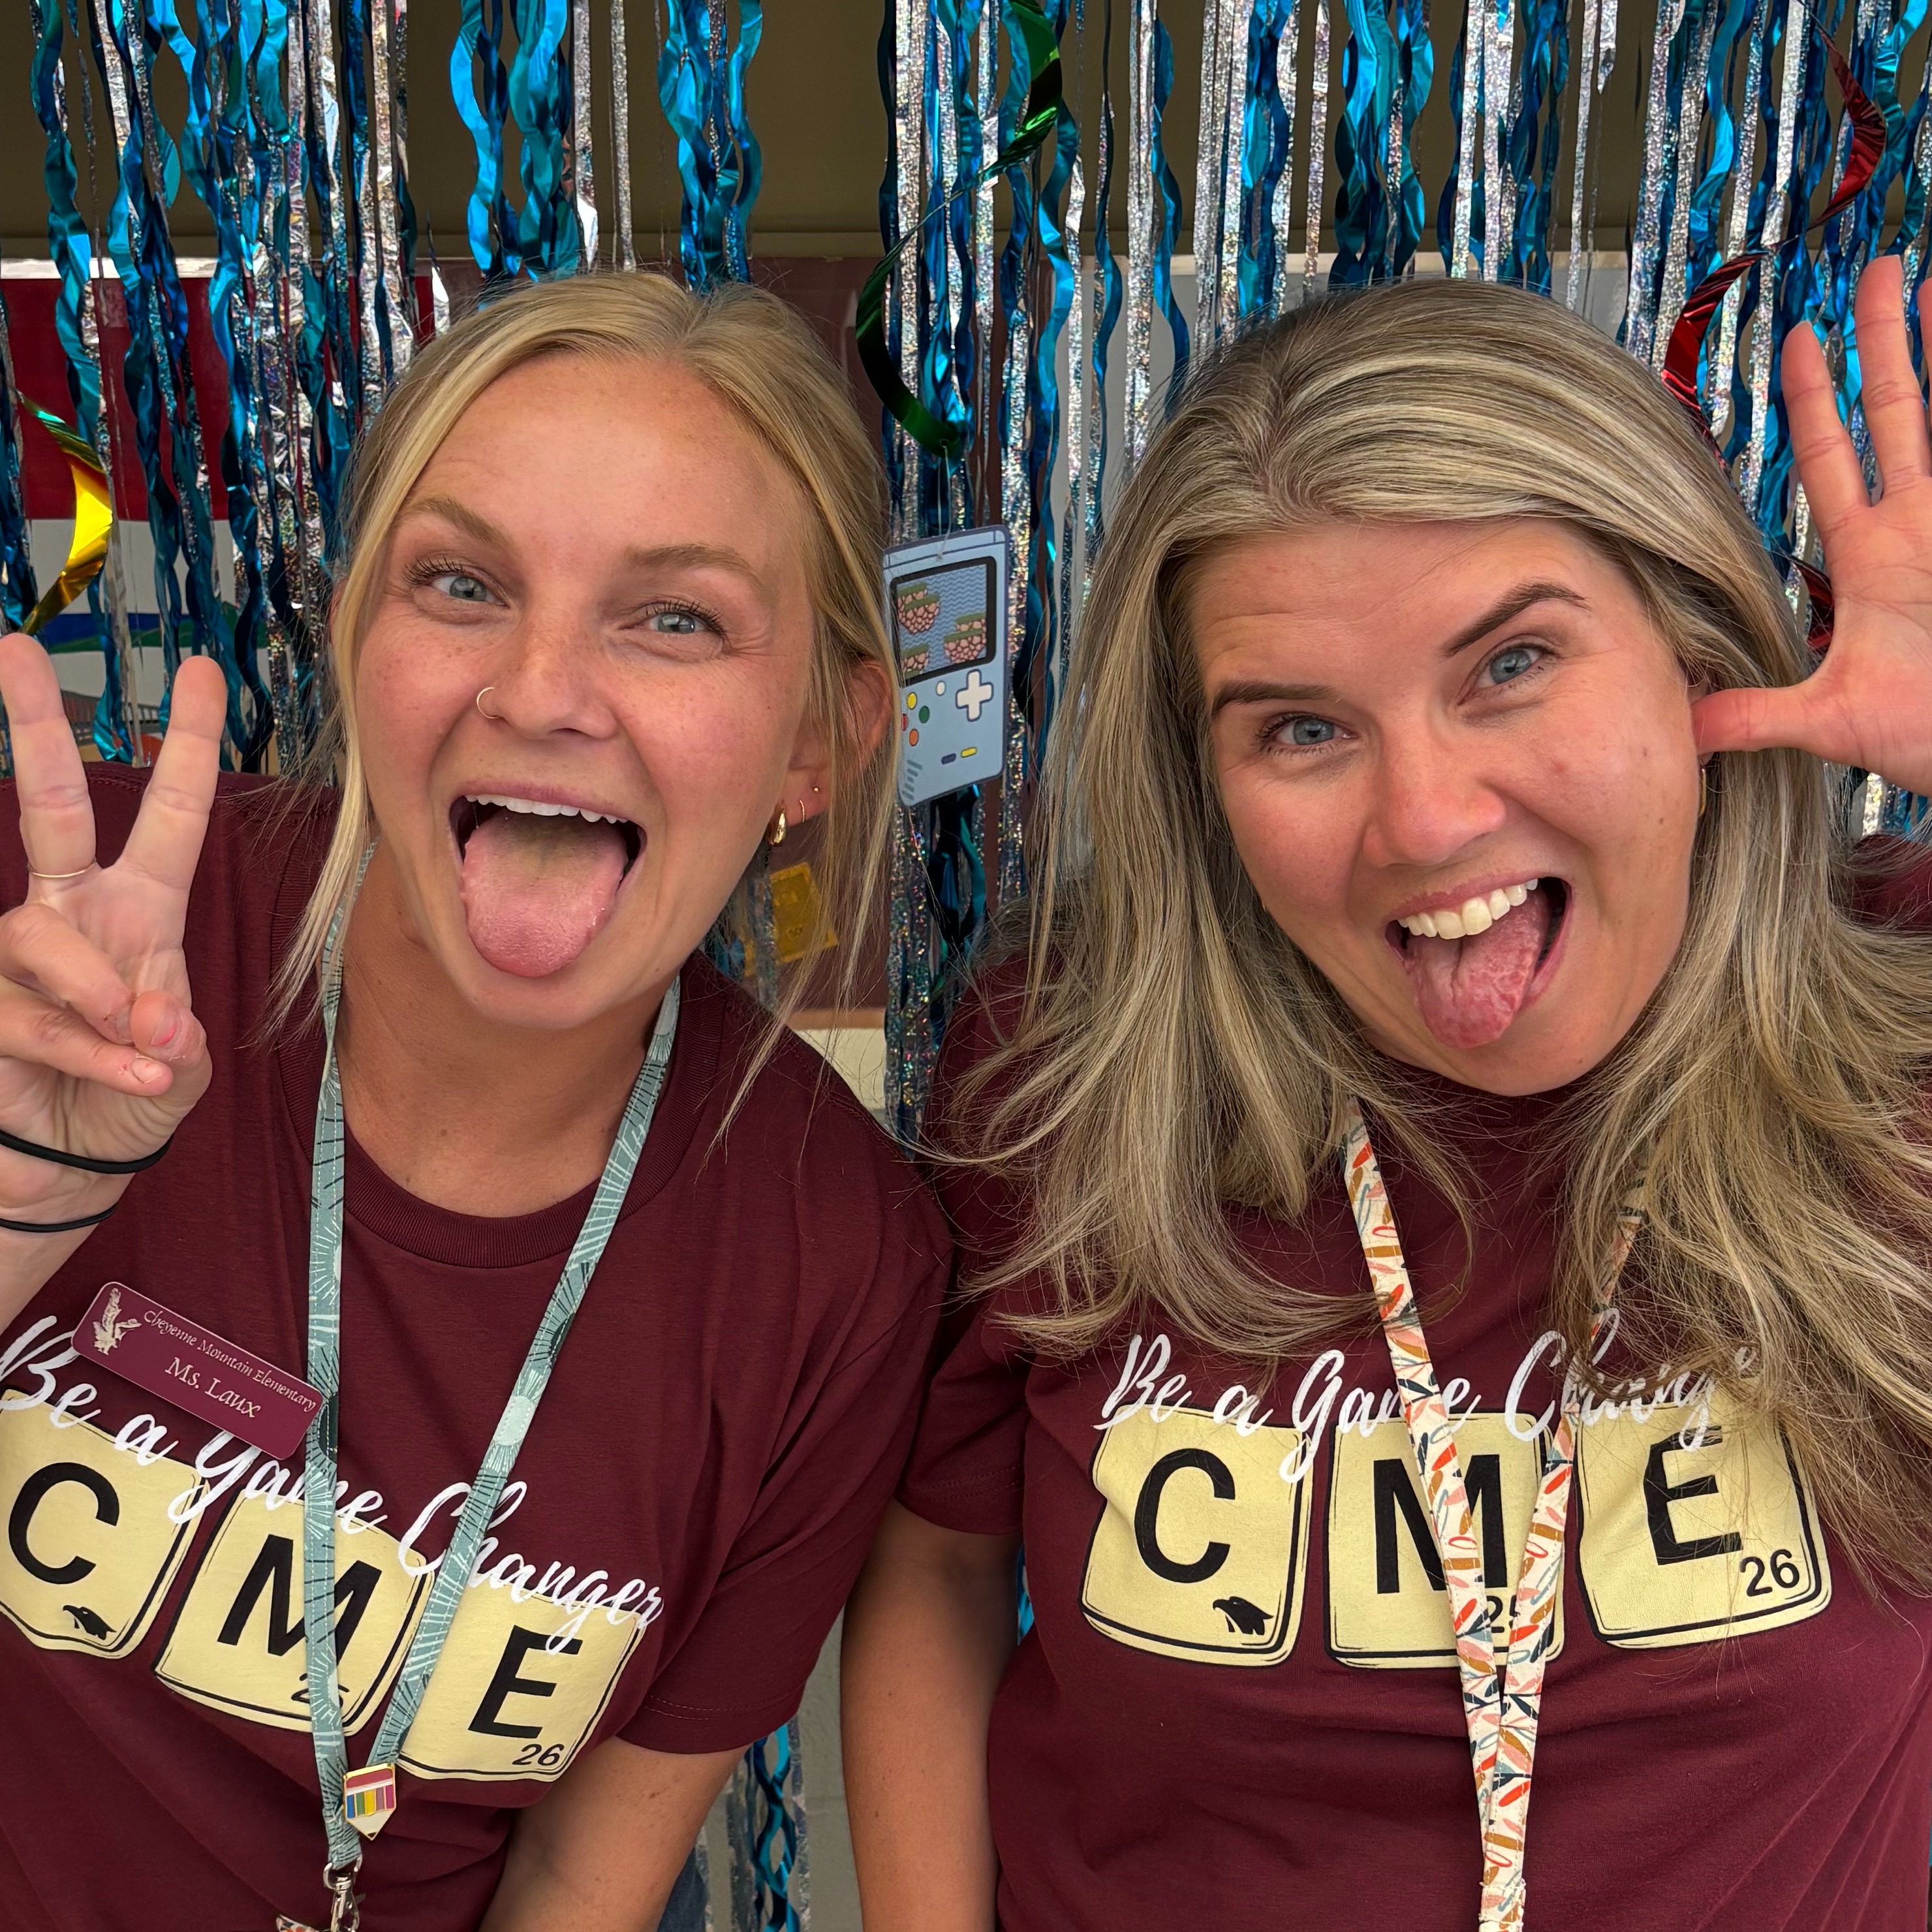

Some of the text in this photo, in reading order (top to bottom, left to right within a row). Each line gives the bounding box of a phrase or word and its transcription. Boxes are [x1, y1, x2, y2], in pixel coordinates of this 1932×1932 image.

[0, 1315, 101, 1429] Be
[115, 1414, 179, 1467] a
[143, 1309, 317, 1412] Cheyenne Mountain Elementary
[164, 1356, 262, 1419] Ms. Laux
[1093, 1333, 1192, 1430] Be
[1213, 1384, 1274, 1437] a
[1134, 1425, 1743, 1595] C M E
[8, 1462, 583, 1739] C M E
[1739, 1549, 1800, 1597] 26
[512, 1743, 565, 1766] 26
